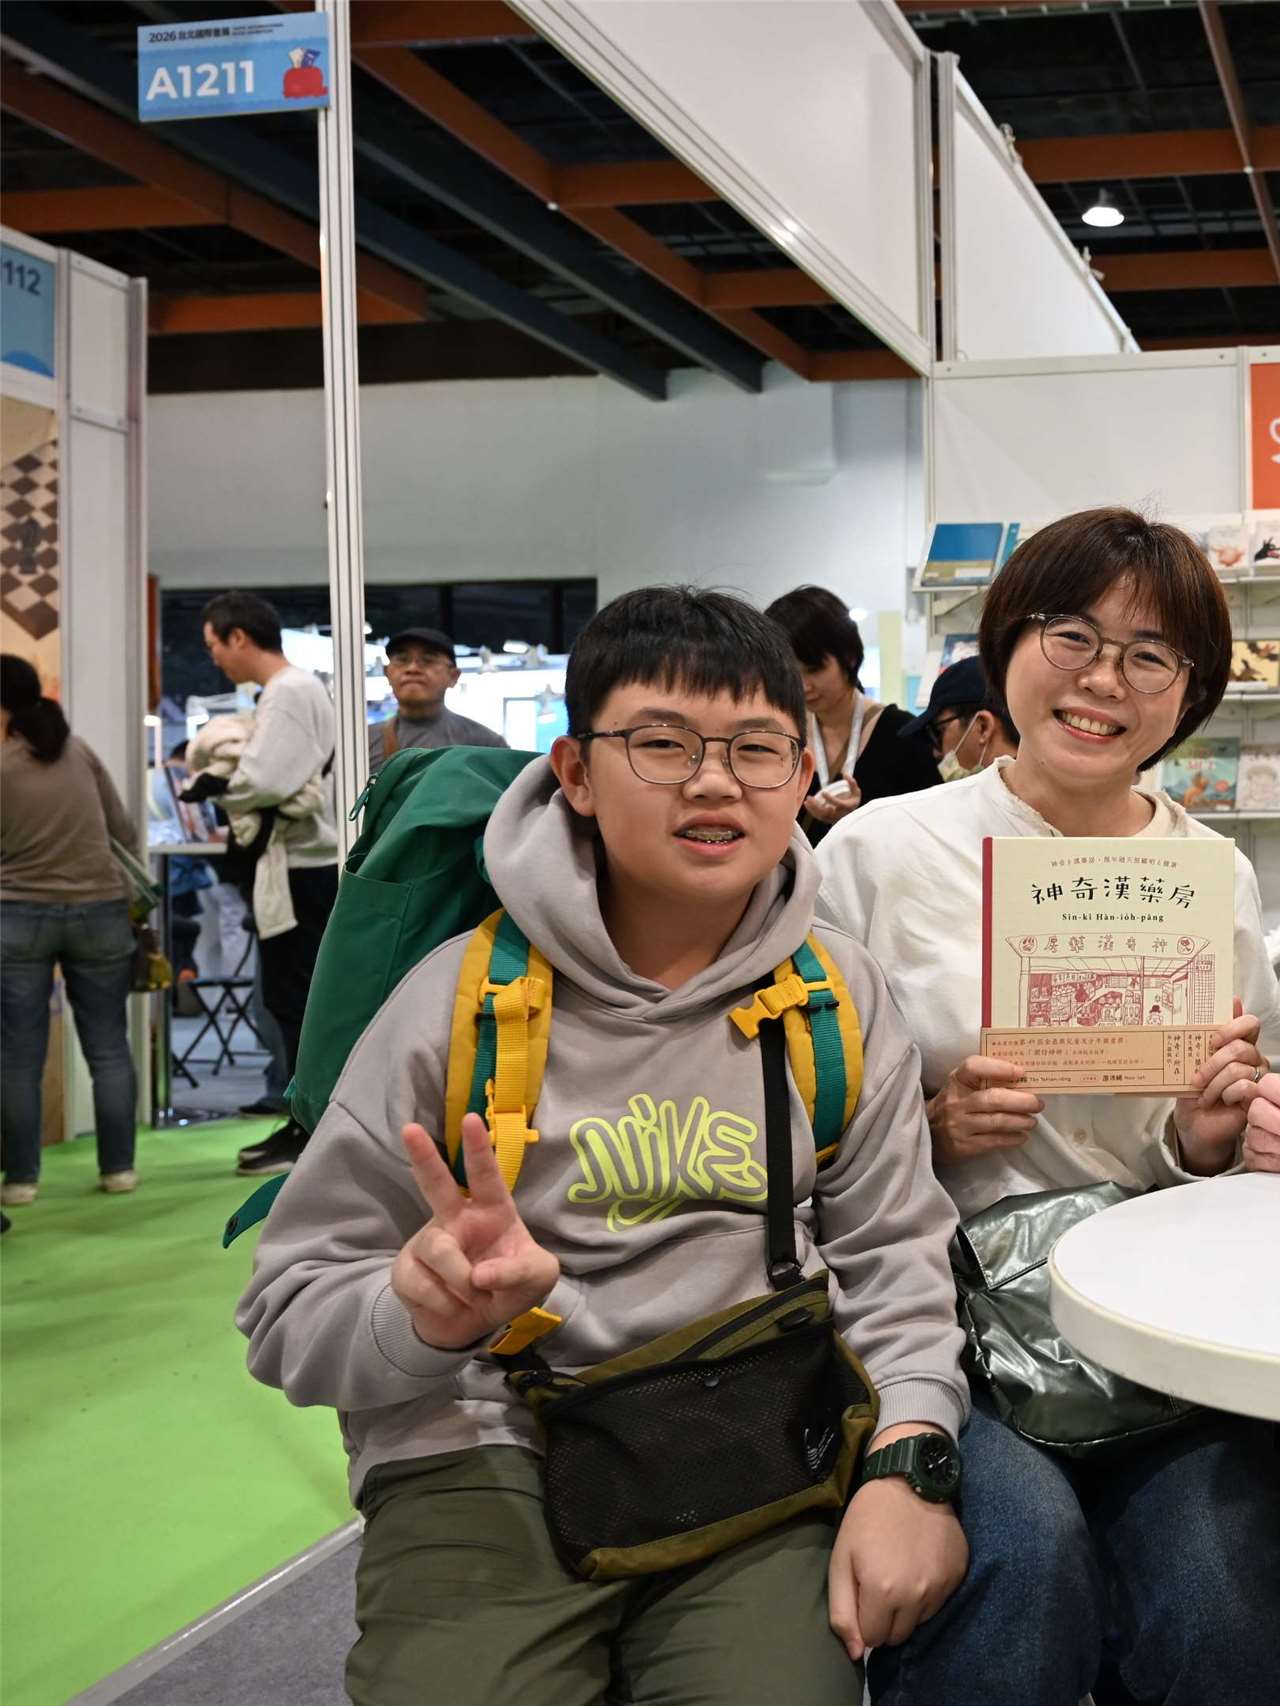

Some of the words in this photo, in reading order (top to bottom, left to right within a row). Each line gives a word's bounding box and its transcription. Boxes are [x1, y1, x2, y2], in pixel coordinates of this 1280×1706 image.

[149, 31, 177, 43] 2026
[146, 60, 254, 101] A1211
[1031, 875, 1195, 909] 神奇漢藥房
